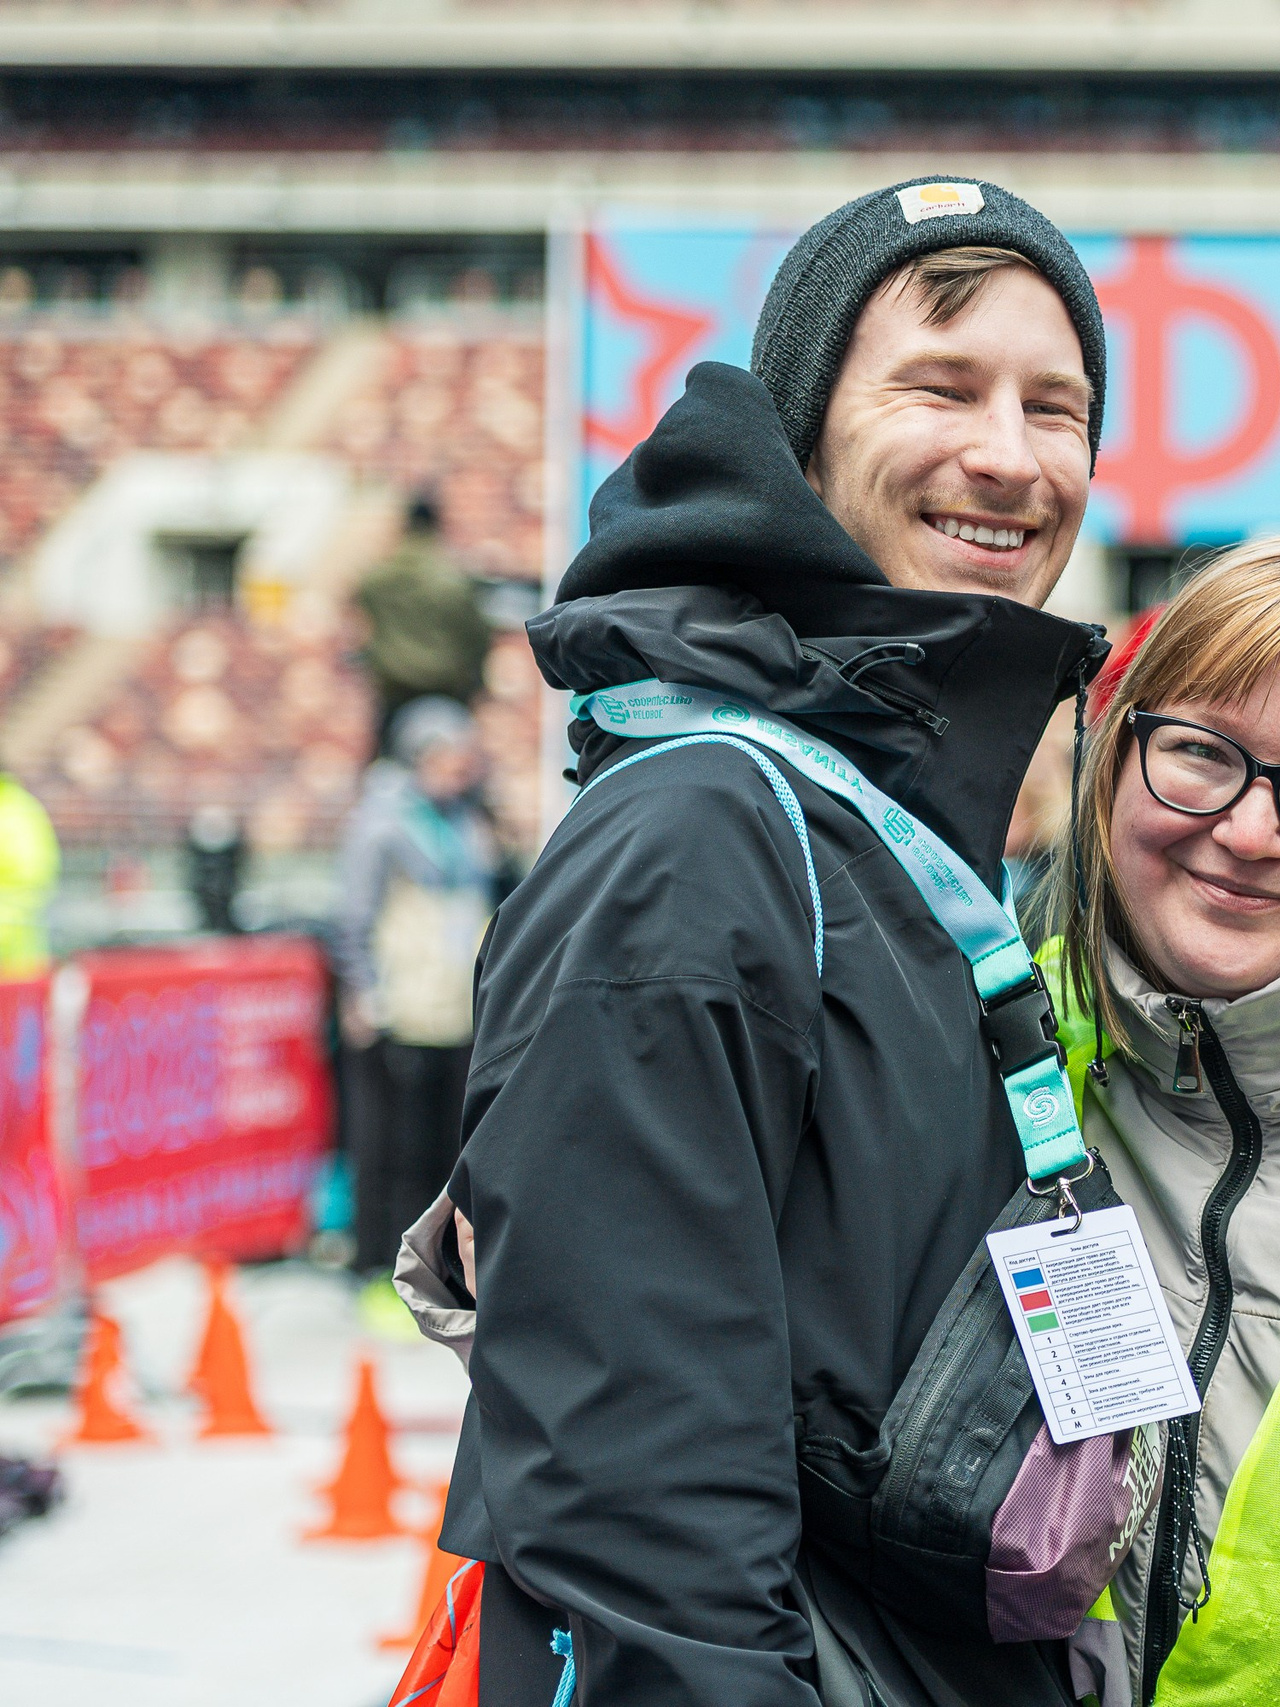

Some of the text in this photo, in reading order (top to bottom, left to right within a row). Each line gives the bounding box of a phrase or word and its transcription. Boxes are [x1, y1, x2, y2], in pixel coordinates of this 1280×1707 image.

[1051, 1350, 1058, 1358] 2
[1056, 1364, 1062, 1372] 3
[1065, 1392, 1072, 1401] 5
[1070, 1407, 1076, 1415] 6
[1121, 1425, 1143, 1492] THE
[1108, 1441, 1150, 1562] NORTH
